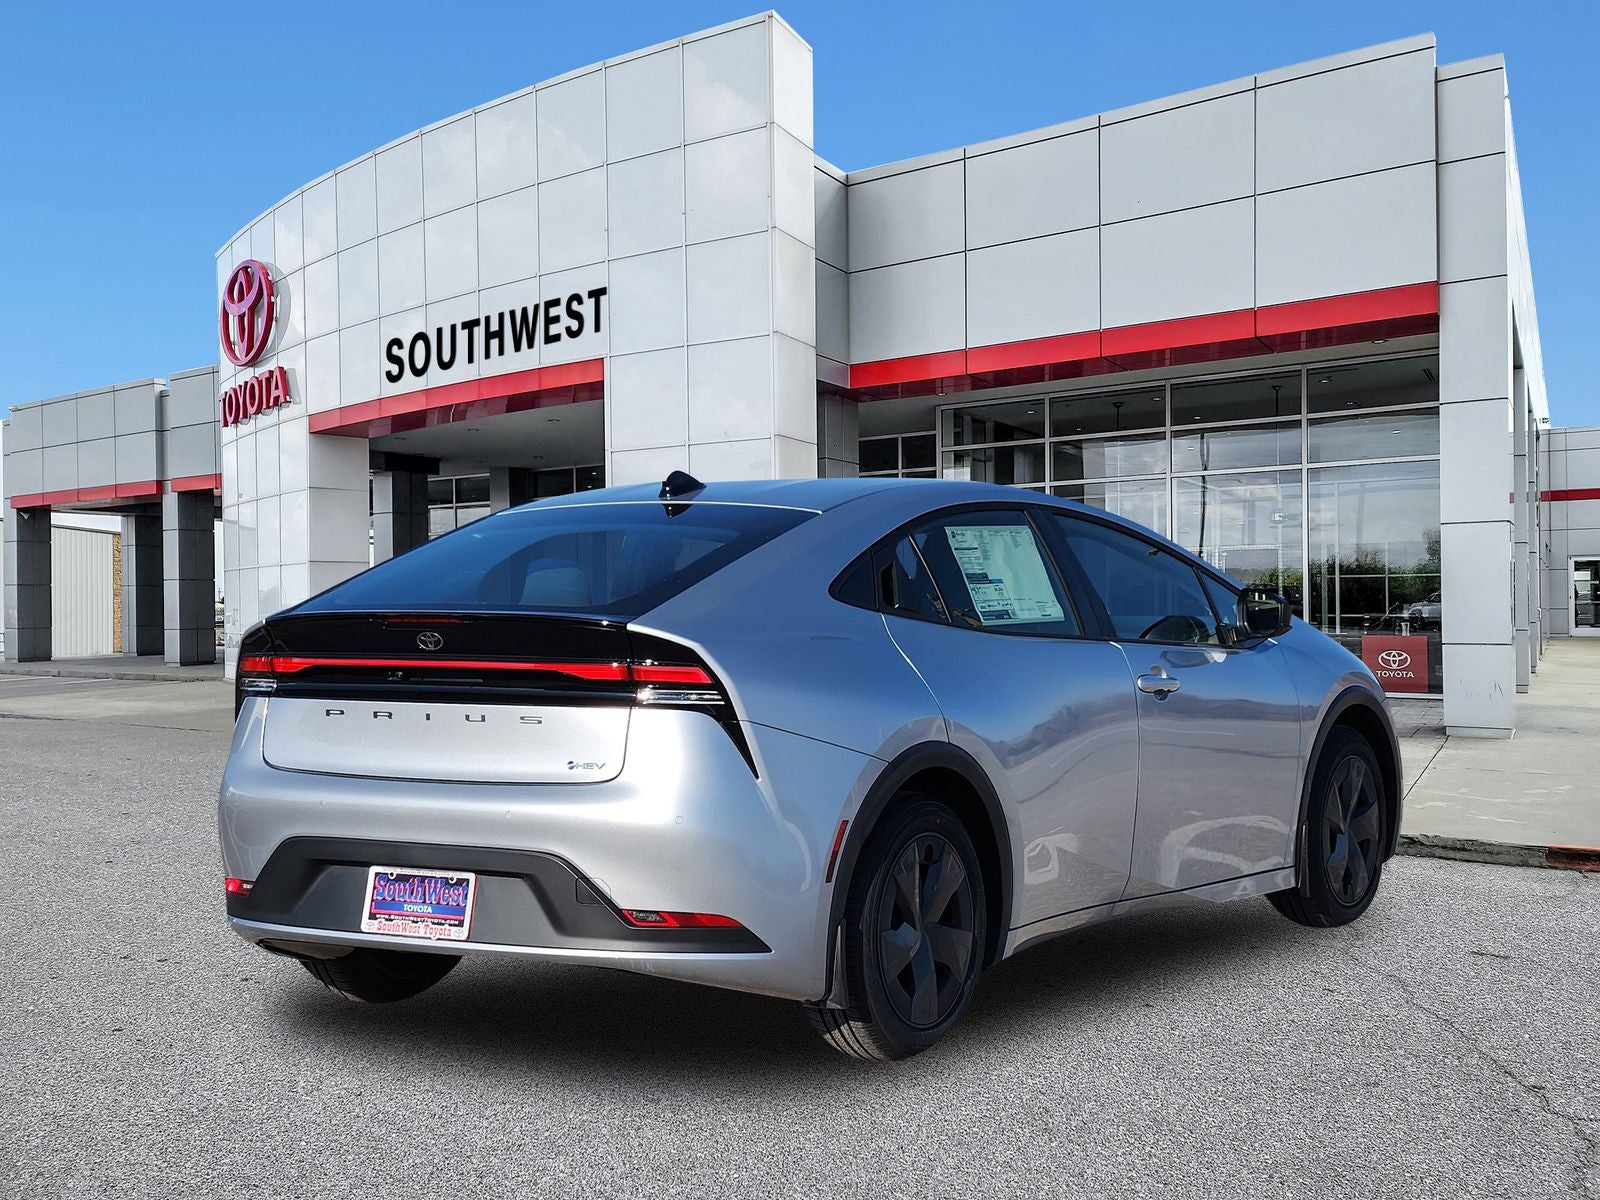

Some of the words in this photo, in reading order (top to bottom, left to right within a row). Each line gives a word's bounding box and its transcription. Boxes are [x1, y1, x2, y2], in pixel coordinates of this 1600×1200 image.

[385, 286, 607, 384] SOUTHWEST
[218, 366, 290, 428] TOYOTA
[1376, 670, 1414, 678] TOYOTA
[325, 709, 543, 725] PRIUS
[575, 761, 606, 770] HEV
[373, 873, 469, 906] SouthWest
[403, 903, 433, 914] TOYOTA
[376, 920, 421, 935] SouthWest
[423, 924, 452, 938] Toyota
